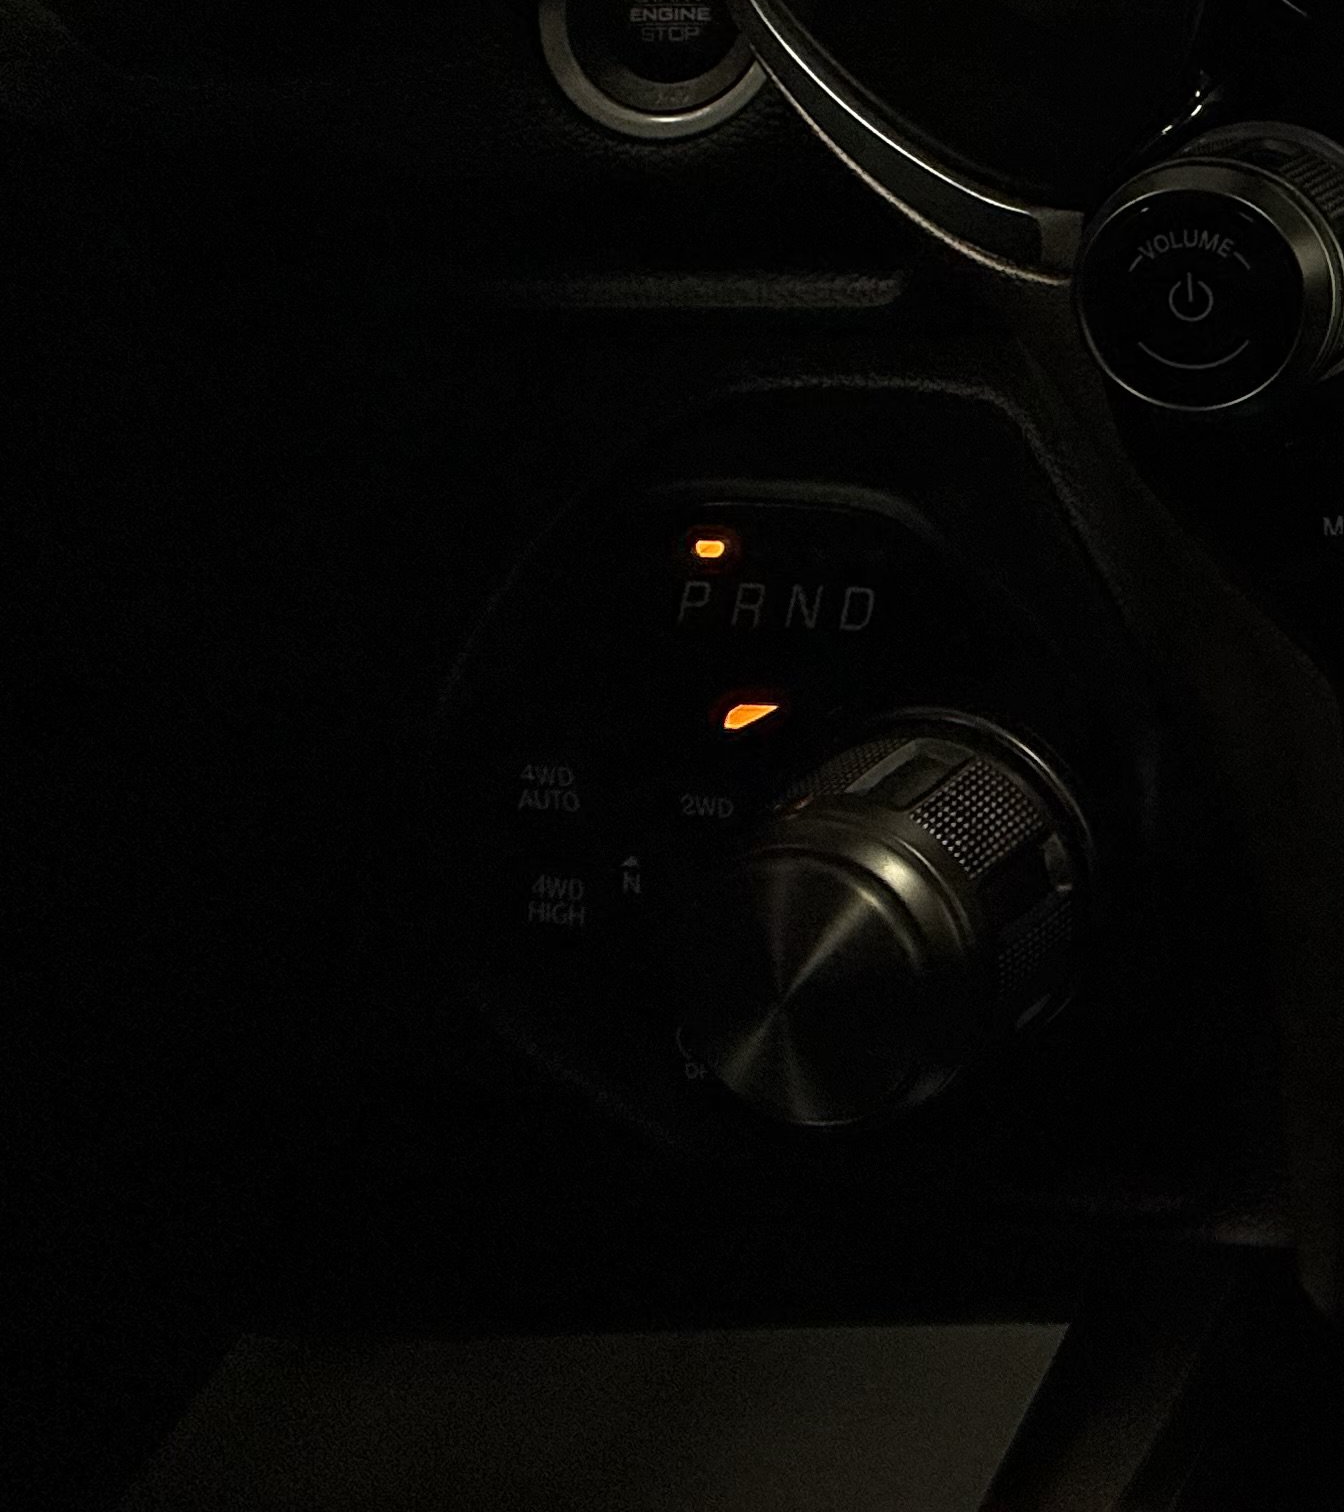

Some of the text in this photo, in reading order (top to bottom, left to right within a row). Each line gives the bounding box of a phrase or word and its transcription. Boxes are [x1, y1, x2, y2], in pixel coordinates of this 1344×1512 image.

[629, 7, 712, 22] ENGINE
[640, 26, 701, 42] STOP
[1139, 229, 1235, 260] VOLUME
[519, 764, 575, 788] 4WD
[517, 788, 581, 813] AUTO
[679, 794, 735, 819] 2WD
[531, 874, 584, 901] 4WD
[527, 901, 586, 926] HIGH
